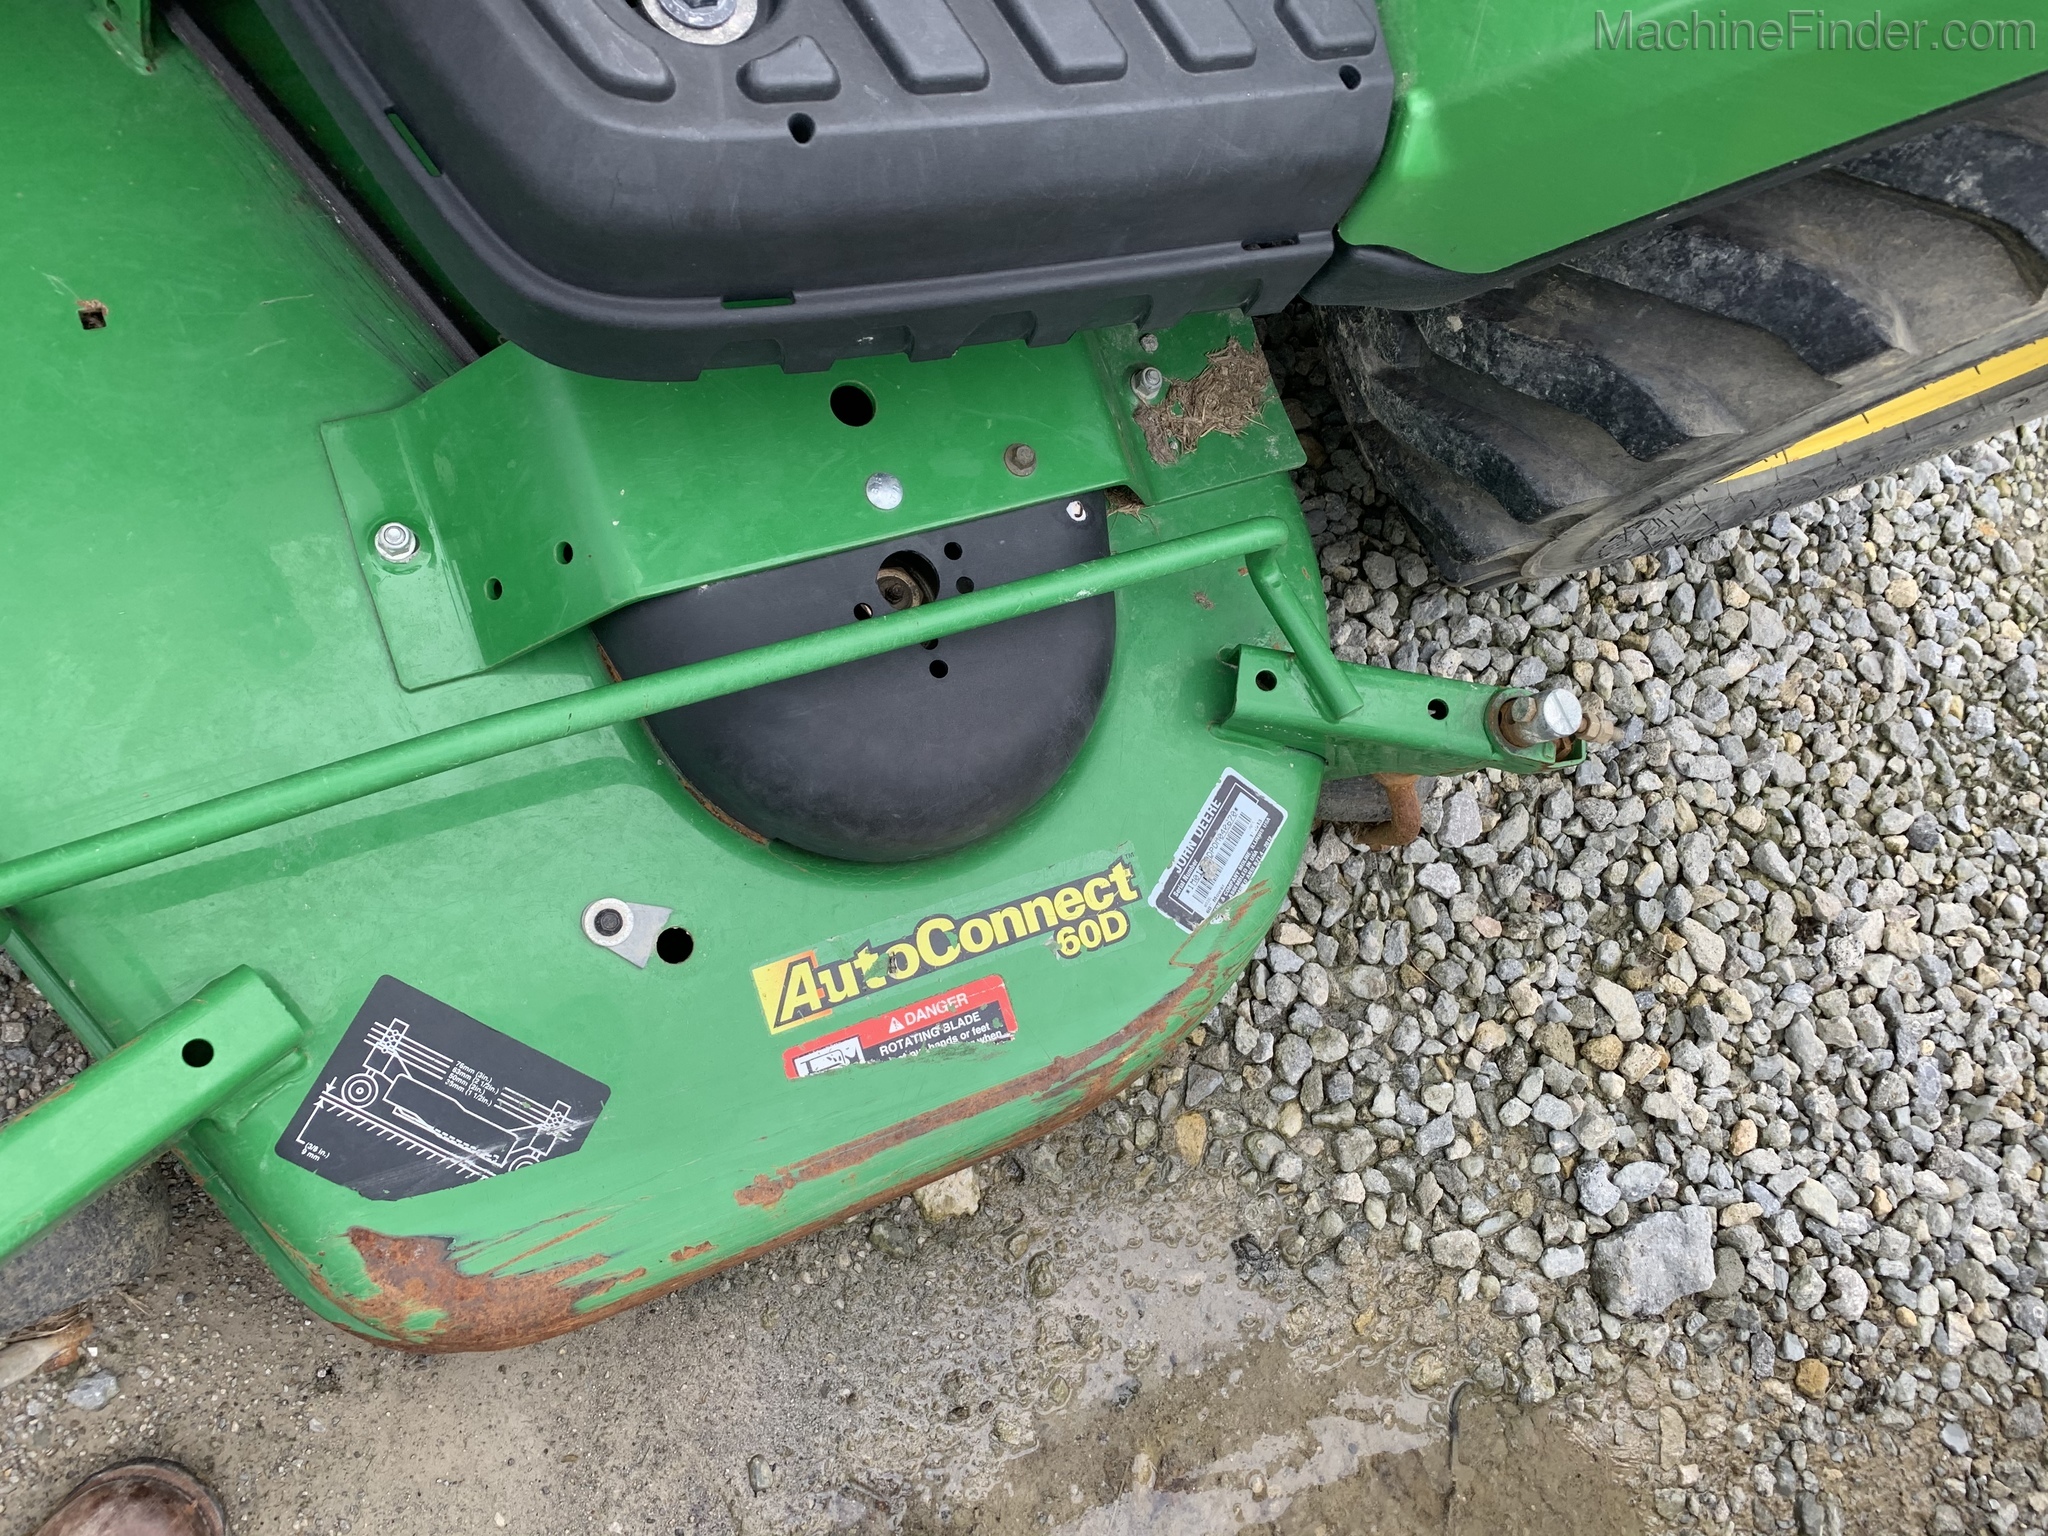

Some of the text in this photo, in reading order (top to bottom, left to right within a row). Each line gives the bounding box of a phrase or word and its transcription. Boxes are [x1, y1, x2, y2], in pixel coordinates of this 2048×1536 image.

[1222, 870, 1240, 896] COMPANY
[1261, 816, 1271, 828] USA
[1227, 867, 1248, 898] ASSEMBLED
[1249, 849, 1258, 861] USA
[1173, 858, 1198, 896] Serial Number
[778, 861, 1138, 1023] AutoConnect
[1055, 909, 1128, 957] 60D
[904, 993, 969, 1026] DANGER
[879, 1028, 940, 1056] ROTATING
[942, 1011, 981, 1033] BLADE
[928, 1035, 958, 1050] hands
[960, 1031, 970, 1041] or
[971, 1022, 991, 1037] feet
[449, 1073, 468, 1087] 50mm
[452, 1067, 472, 1081] 63mm
[456, 1061, 475, 1075] 76mm
[306, 1152, 320, 1162] mm
